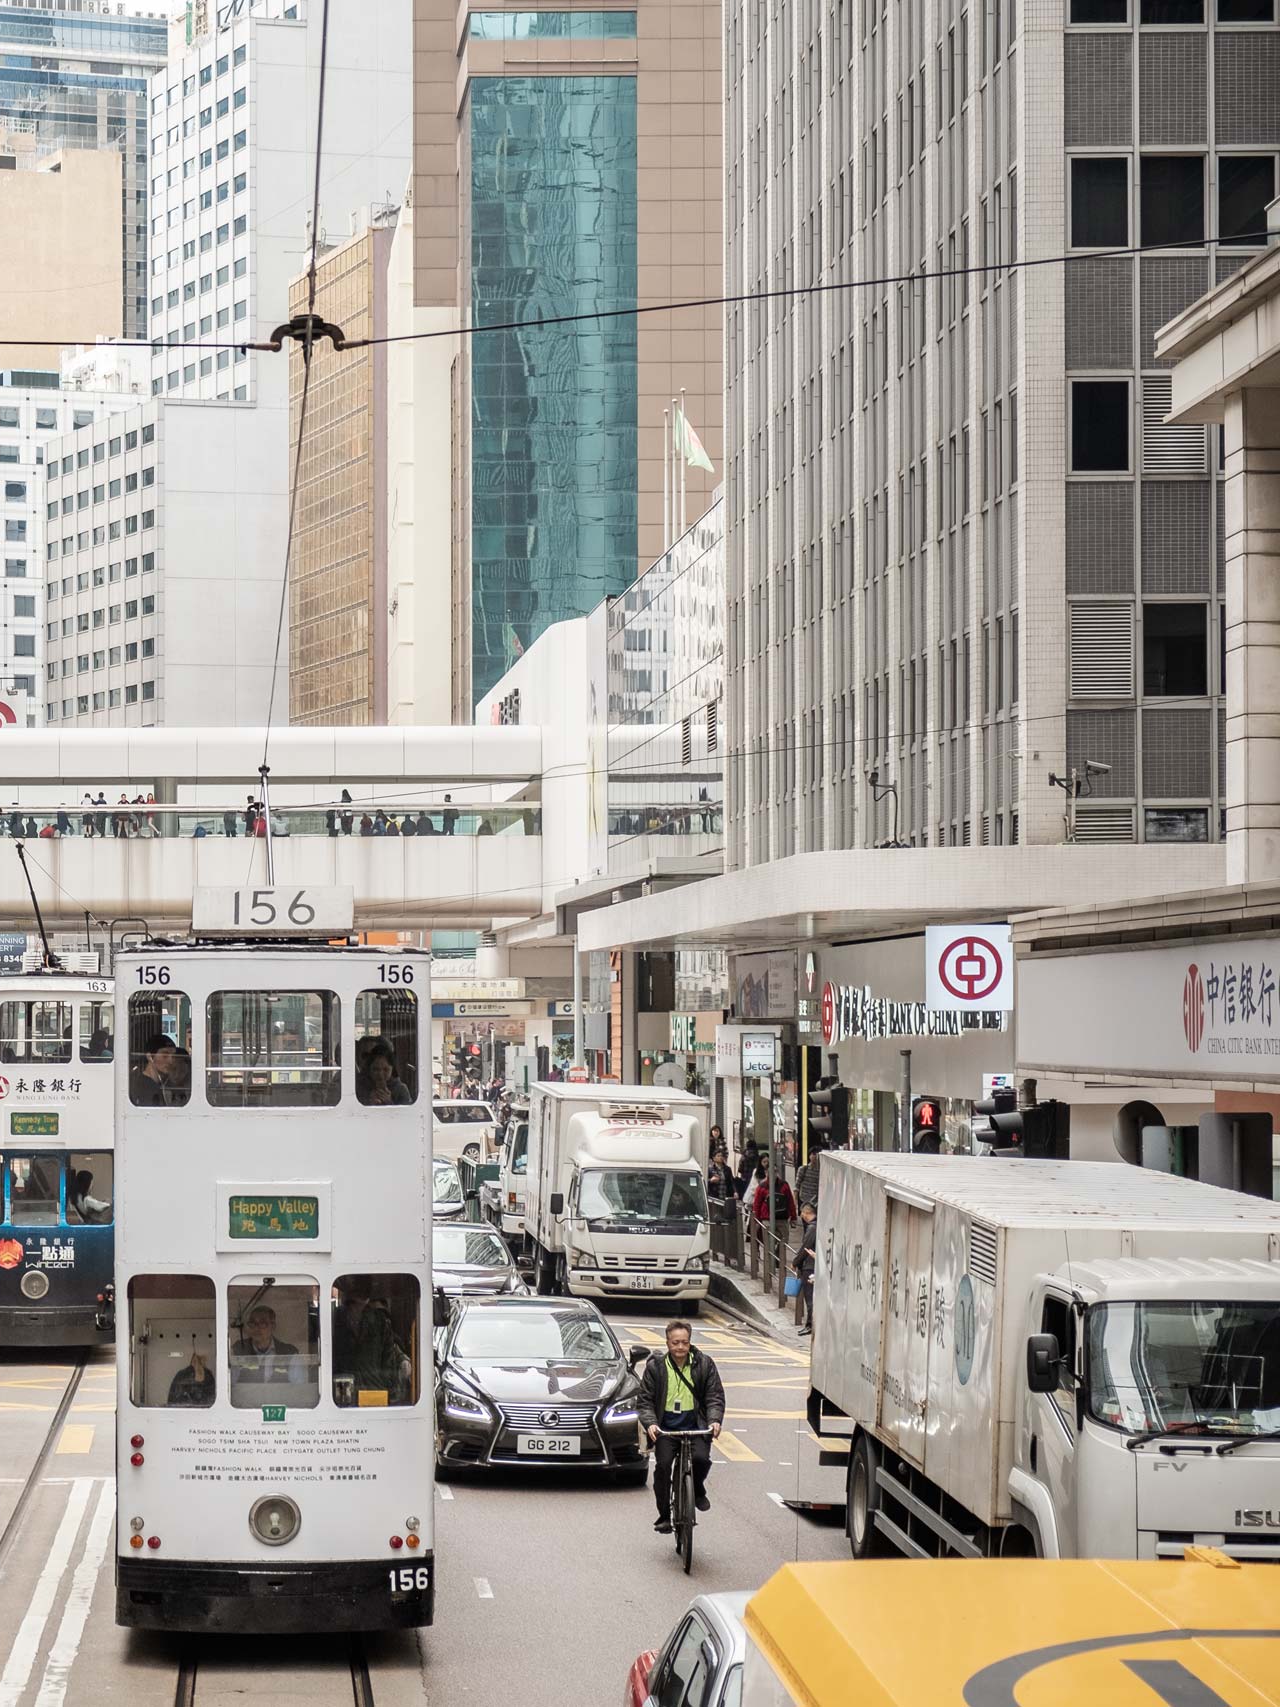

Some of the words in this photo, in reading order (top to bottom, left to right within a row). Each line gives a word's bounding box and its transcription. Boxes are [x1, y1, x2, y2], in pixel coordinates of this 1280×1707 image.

[233, 889, 316, 926] 156
[135, 965, 171, 985] 156
[377, 964, 414, 984] 156
[87, 981, 107, 992] 163
[890, 1002, 913, 1035] BANK
[915, 1002, 926, 1035] OF
[1207, 1038, 1226, 1054] CHINA
[1246, 1038, 1262, 1054] BANK
[15, 1078, 82, 1093] 永隆銀行
[232, 1200, 273, 1216] Happy
[278, 1200, 317, 1216] Valley
[527, 1439, 545, 1452] GG
[548, 1439, 571, 1452] 212
[1153, 1462, 1188, 1474] FV
[389, 1567, 429, 1592] 156
